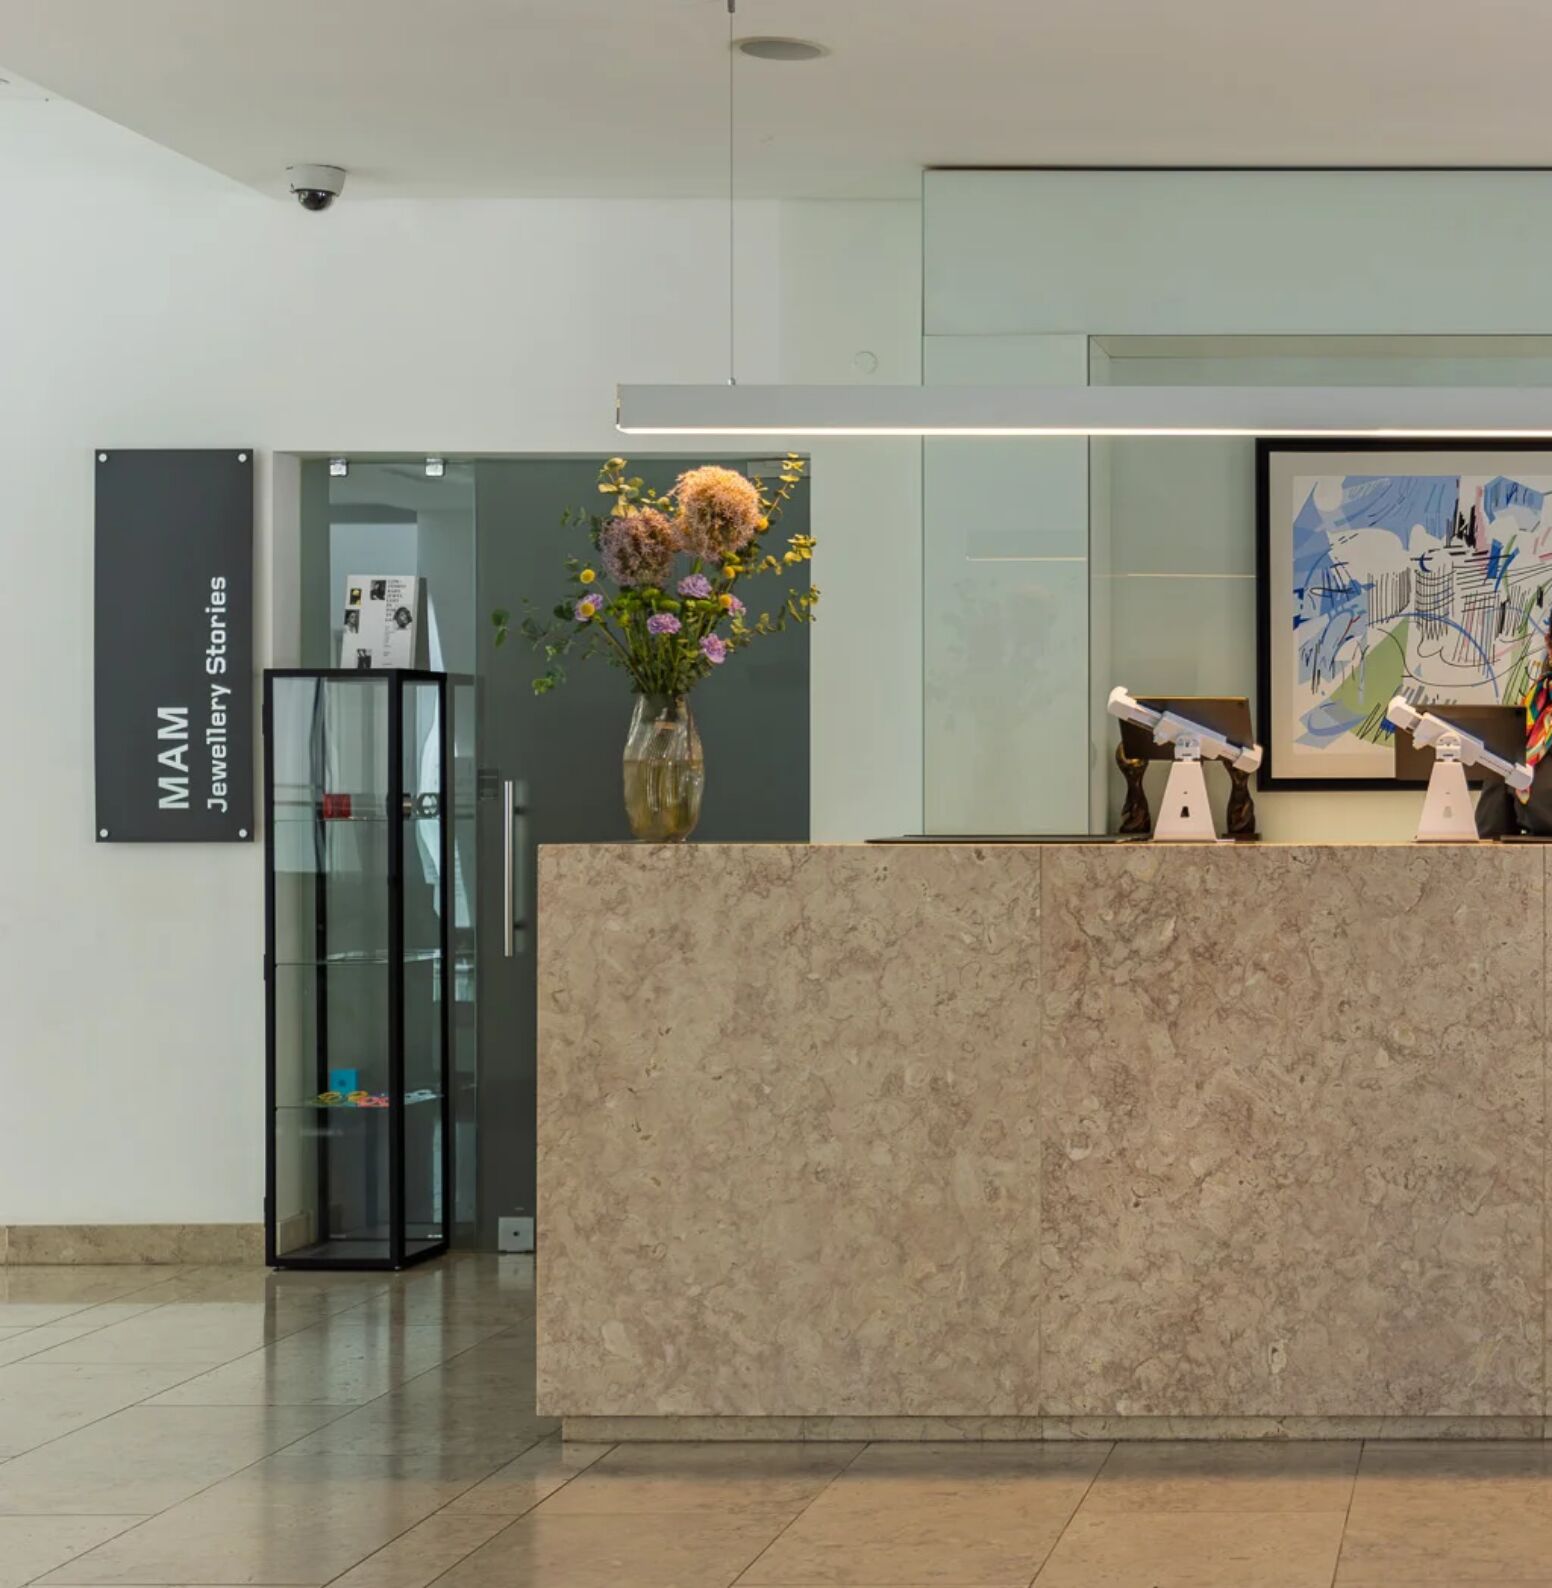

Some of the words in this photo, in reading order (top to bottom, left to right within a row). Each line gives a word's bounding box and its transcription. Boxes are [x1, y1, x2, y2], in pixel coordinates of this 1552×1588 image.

[204, 576, 227, 675] Stories
[158, 707, 190, 810] MAM
[206, 683, 231, 813] Jewellery
